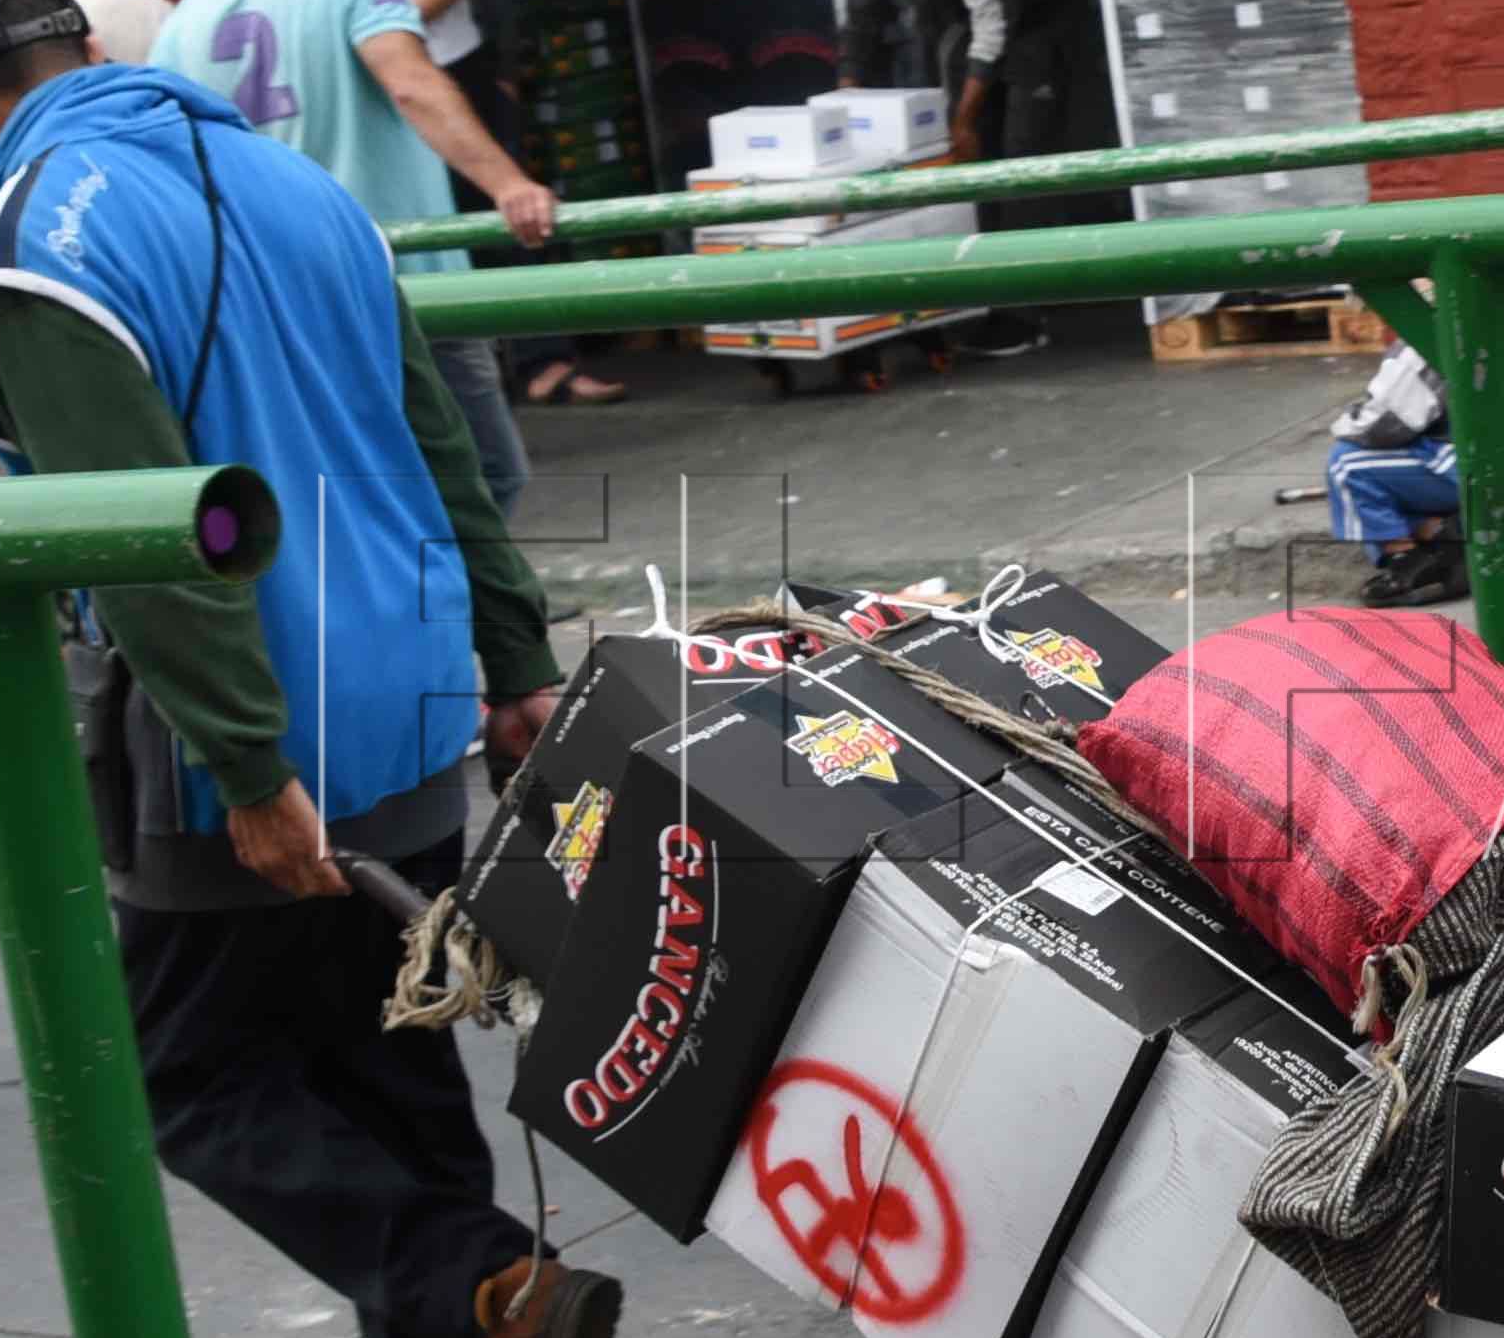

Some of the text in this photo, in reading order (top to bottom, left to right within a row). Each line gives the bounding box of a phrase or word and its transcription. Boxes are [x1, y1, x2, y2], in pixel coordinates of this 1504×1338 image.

[211, 11, 299, 127] 2
[1023, 805, 1072, 839] ESTA
[1128, 869, 1225, 934] CONTIENE
[563, 823, 704, 1129] GANCEDO
[1263, 1057, 1312, 1095] Azuqueca
[1283, 1050, 1338, 1092] APERITIVO
